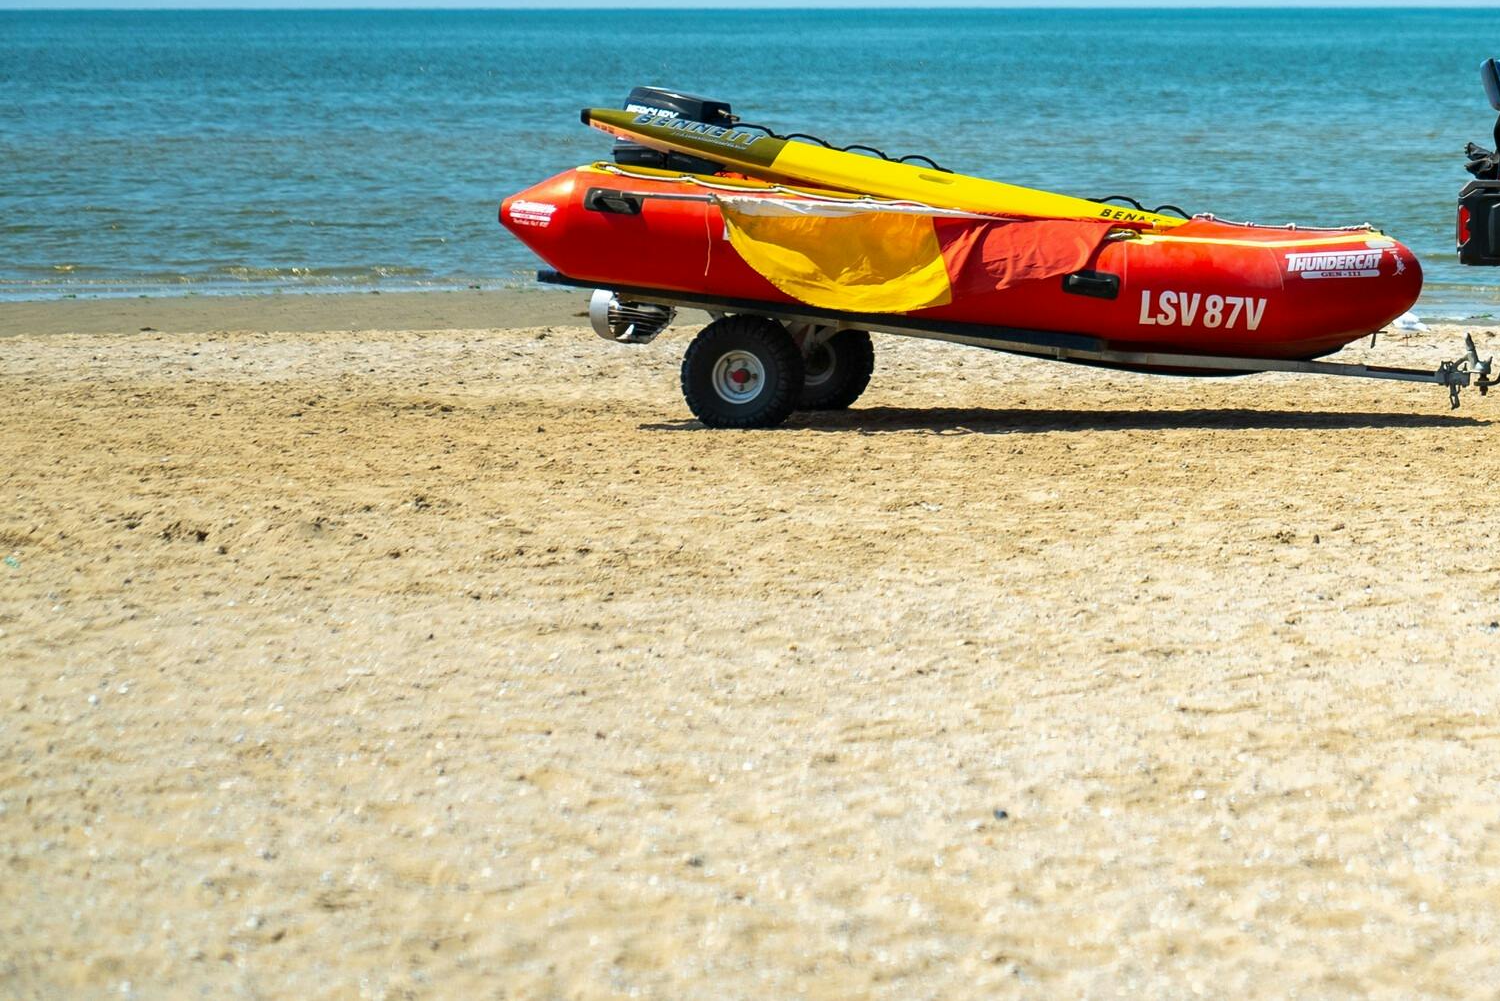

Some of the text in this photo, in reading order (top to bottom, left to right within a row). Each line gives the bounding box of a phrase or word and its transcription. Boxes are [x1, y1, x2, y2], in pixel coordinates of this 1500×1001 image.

[632, 115, 765, 145] BENNETT
[1285, 249, 1383, 271] THUNDERCAT
[1139, 290, 1267, 331] LSV 87V
